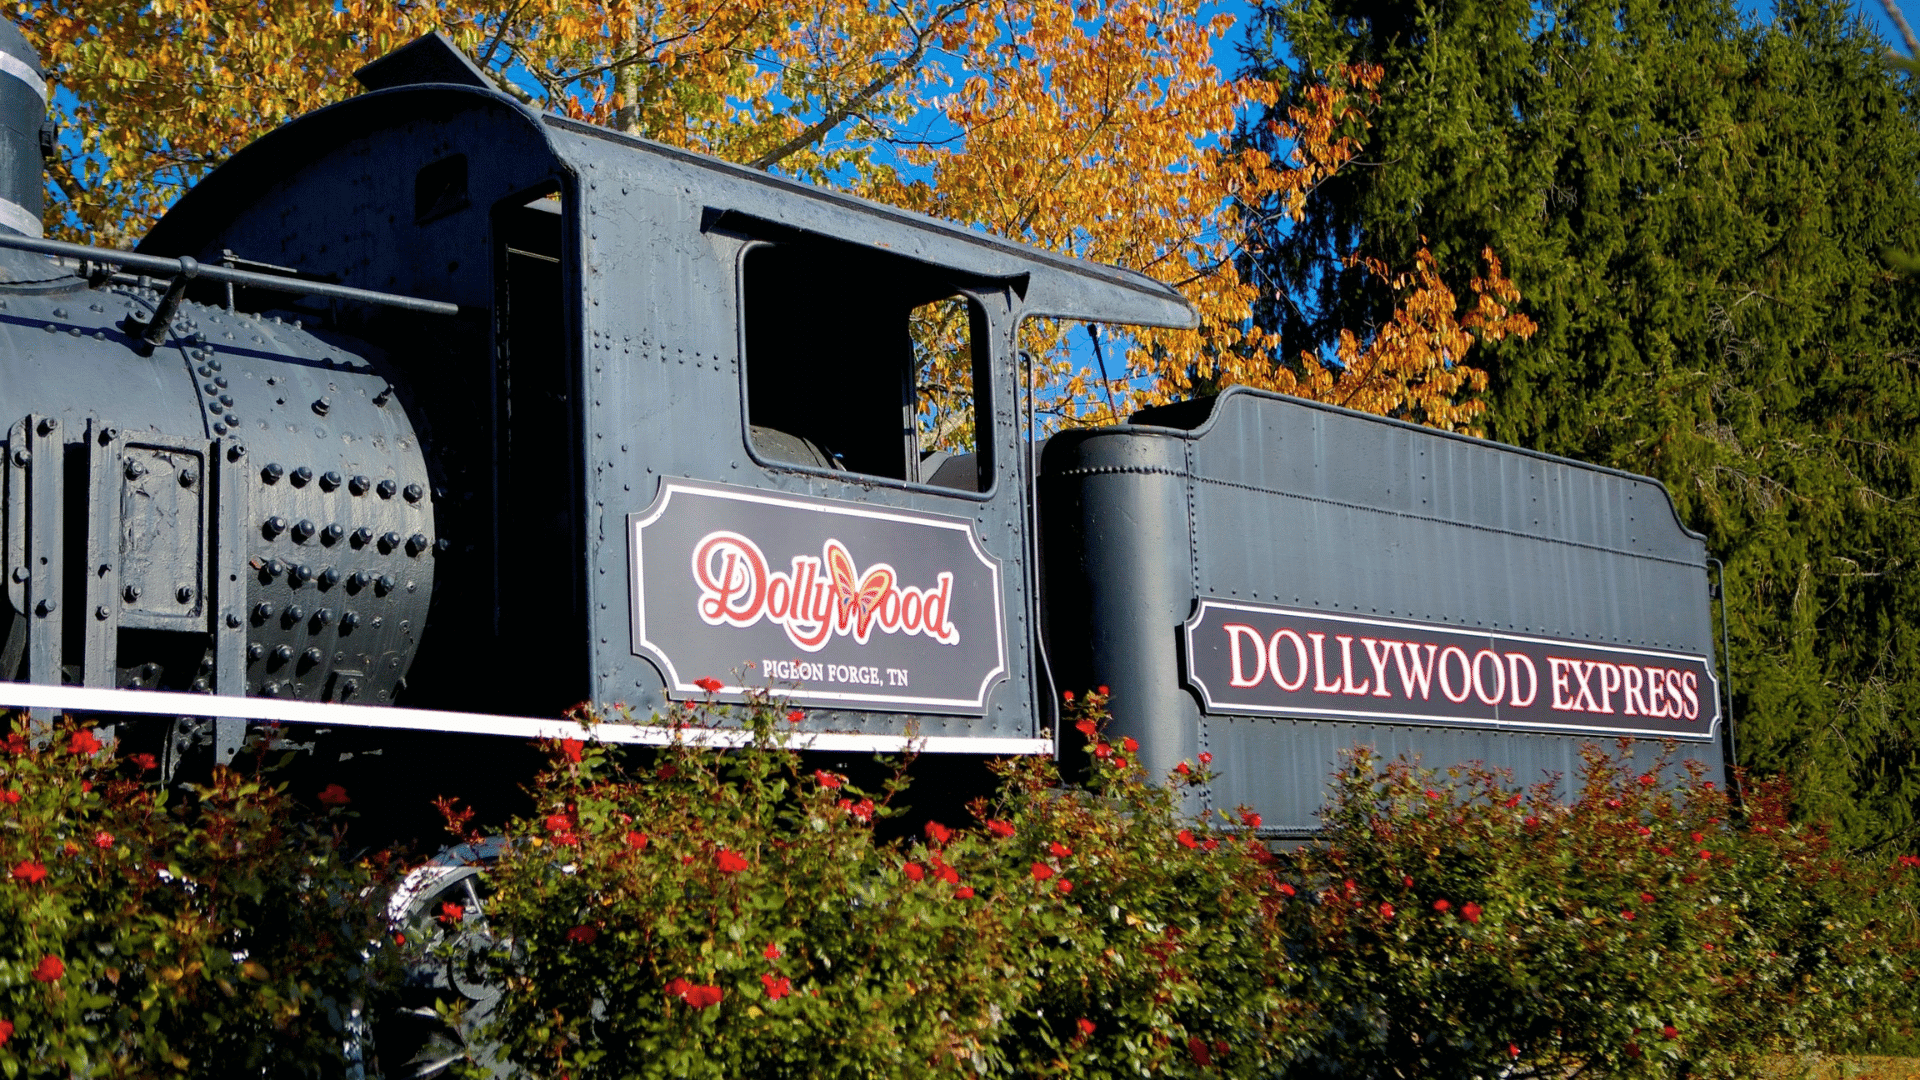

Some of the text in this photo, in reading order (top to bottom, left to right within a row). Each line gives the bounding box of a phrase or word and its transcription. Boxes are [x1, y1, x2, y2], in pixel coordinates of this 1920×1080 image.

[762, 659, 909, 687] PIGEON FORGE, TN
[1223, 624, 1699, 720] DOLLYWOOD EXPRESS
